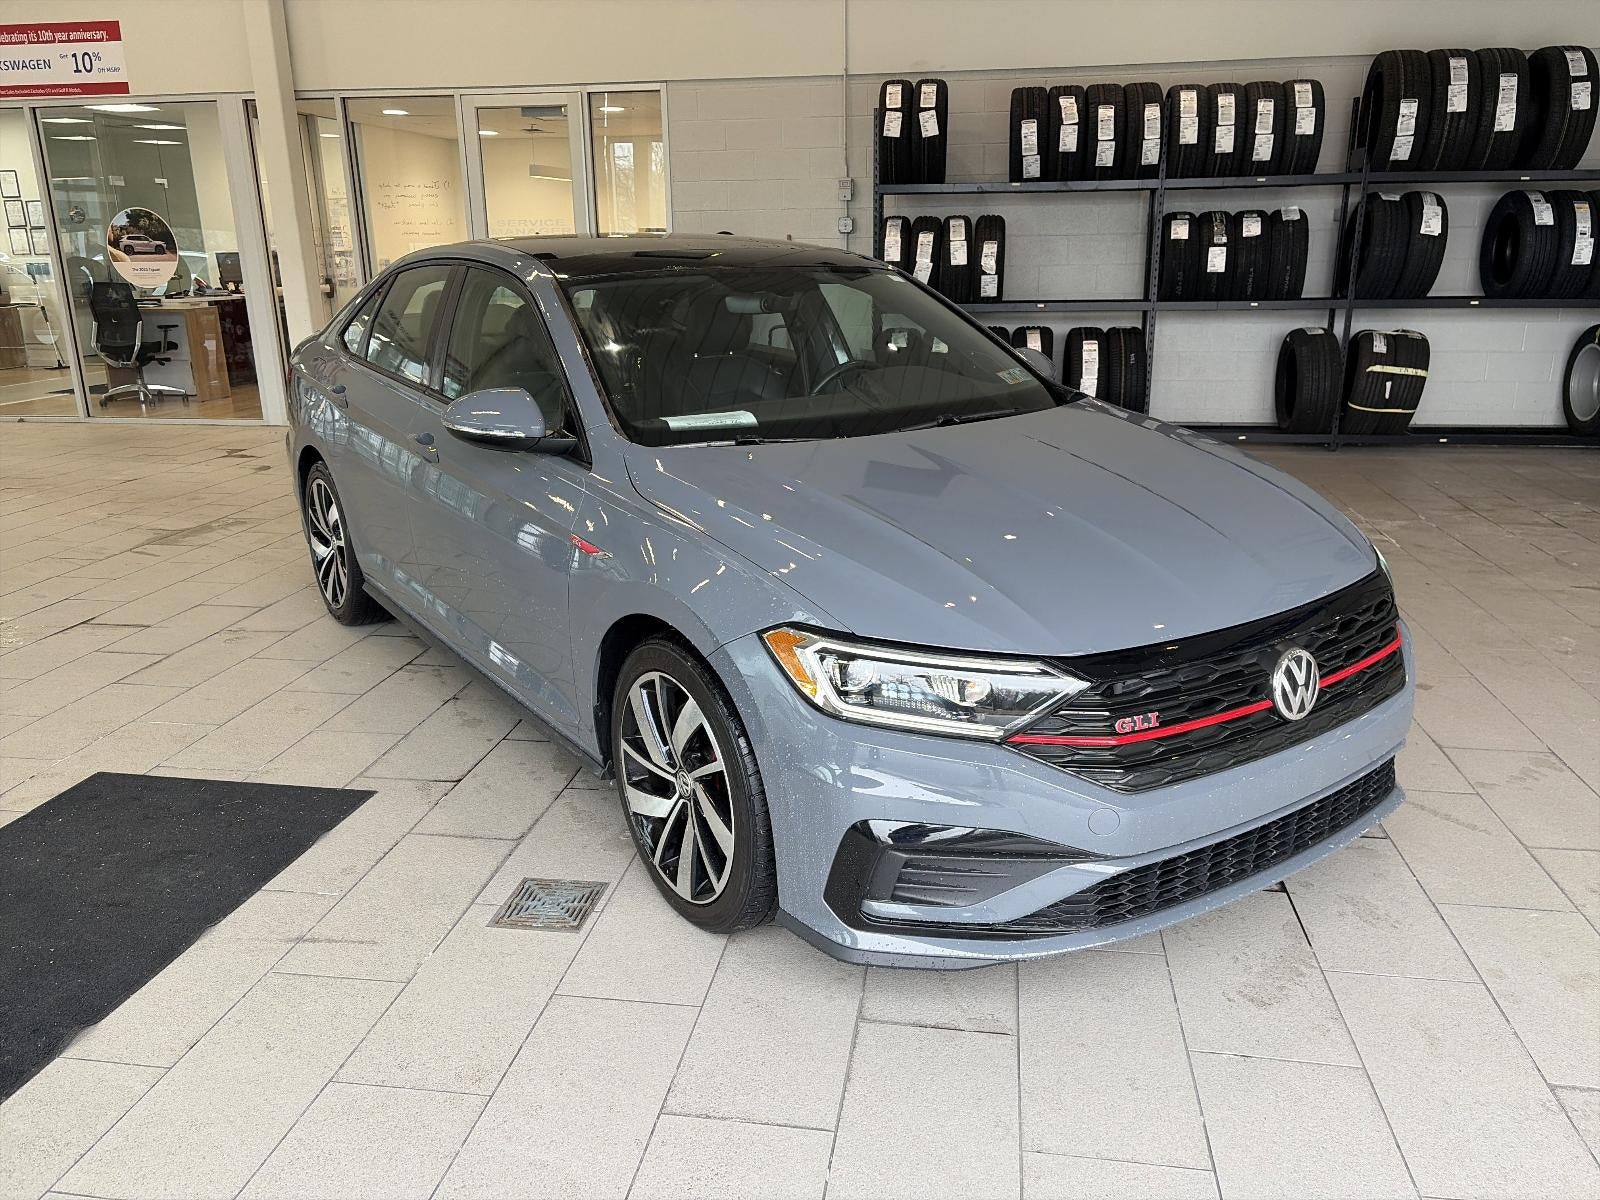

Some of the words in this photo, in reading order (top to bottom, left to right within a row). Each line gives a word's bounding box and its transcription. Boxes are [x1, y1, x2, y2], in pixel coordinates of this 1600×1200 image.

[0, 30, 28, 44] ebrating
[38, 29, 53, 41] 10th
[54, 32, 68, 43] year
[69, 29, 108, 41] anniversary.
[497, 218, 566, 227] SERVICE
[1115, 711, 1159, 733] GLI
